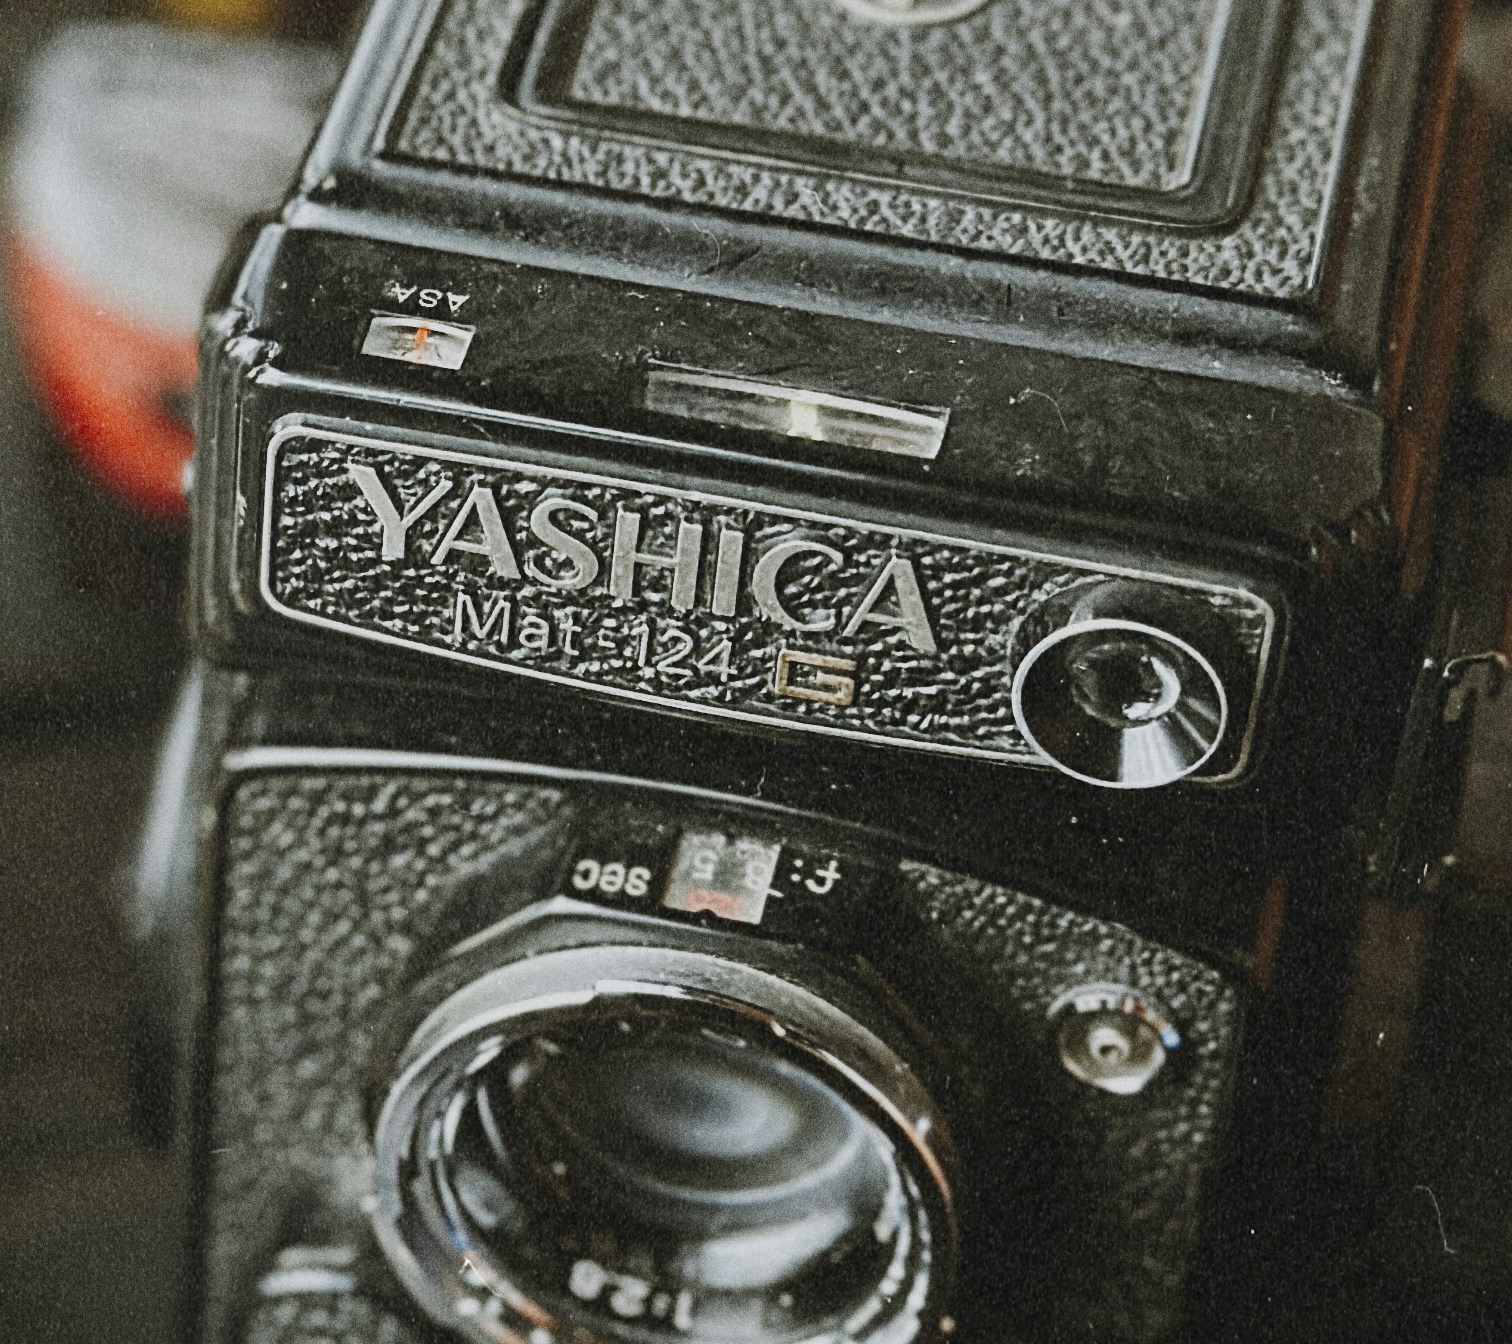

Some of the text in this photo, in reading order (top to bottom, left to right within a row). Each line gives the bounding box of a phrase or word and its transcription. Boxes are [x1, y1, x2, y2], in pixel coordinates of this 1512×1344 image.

[390, 282, 470, 313] ASA
[348, 463, 937, 653] YASHICA
[775, 649, 857, 706] G
[572, 858, 652, 897] sec
